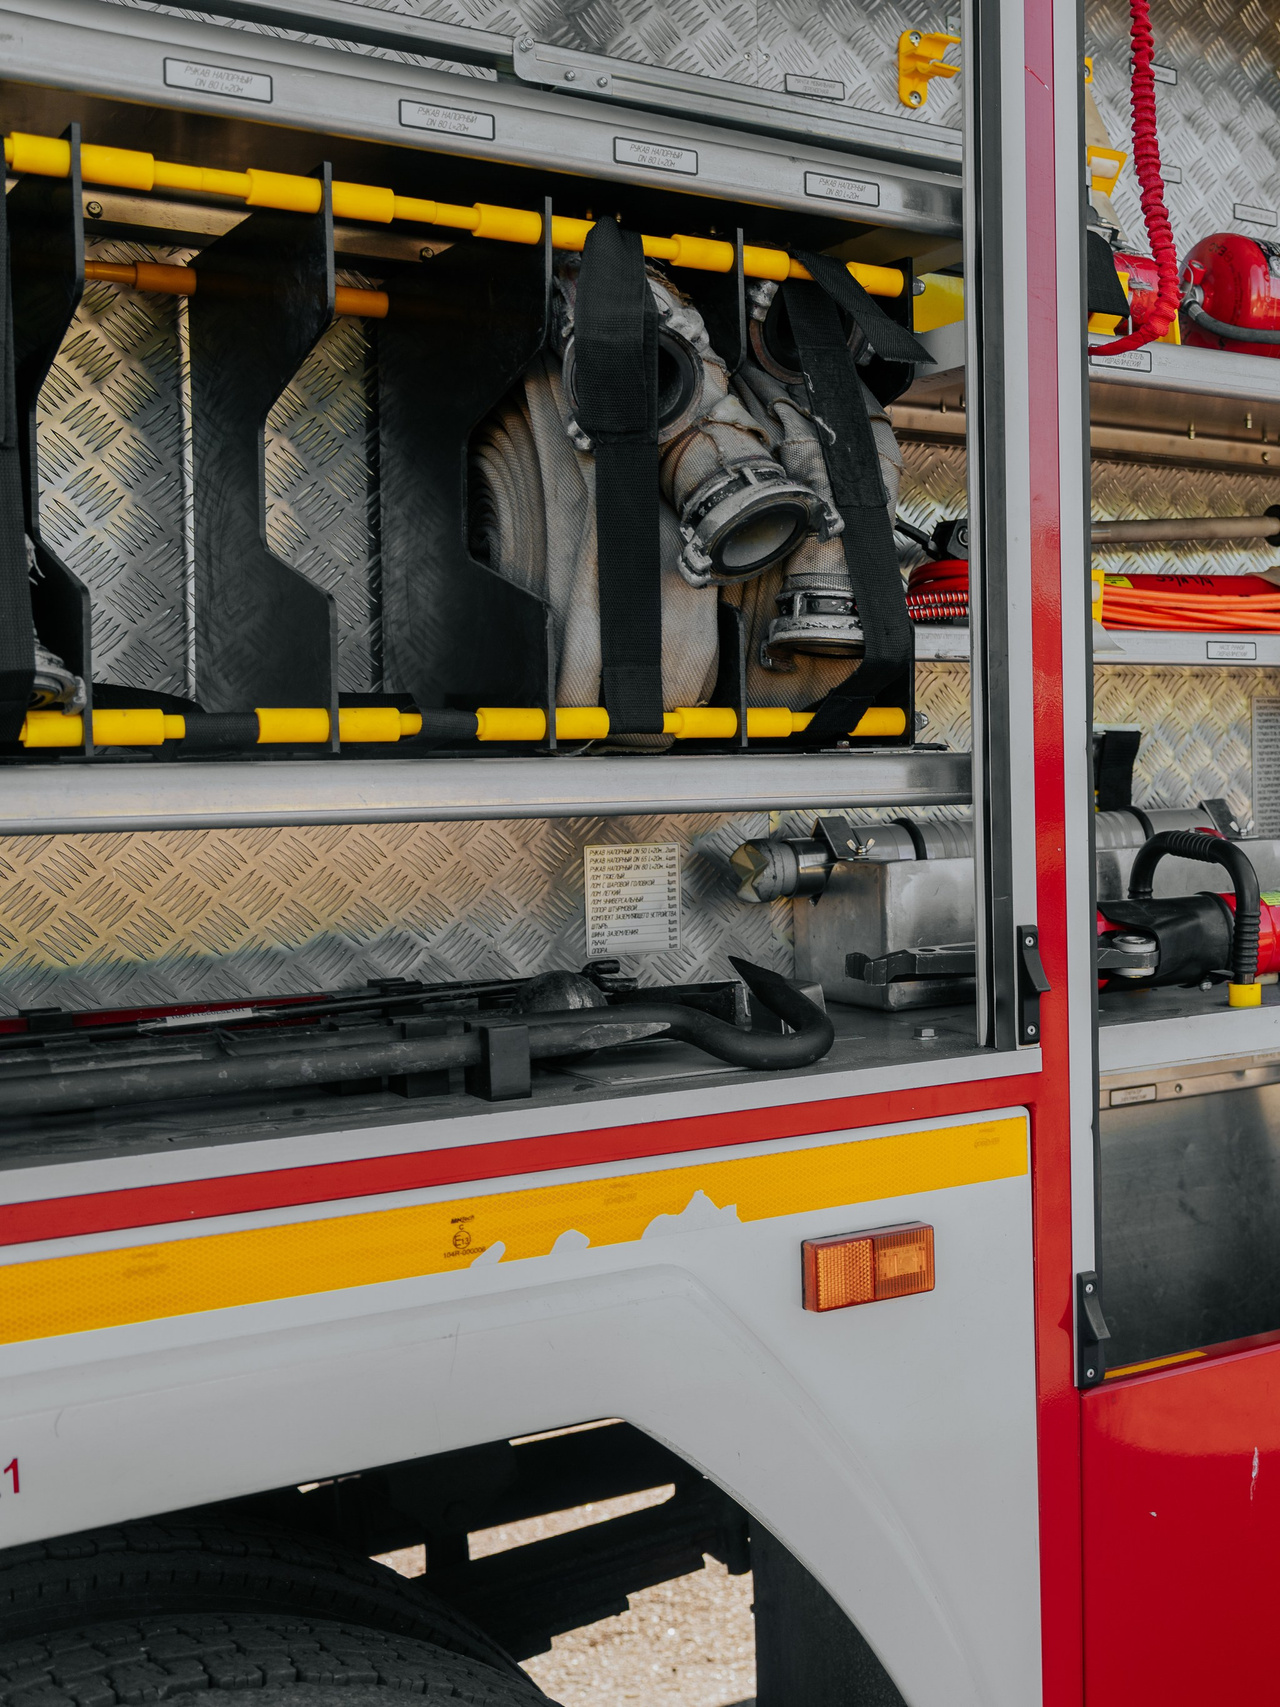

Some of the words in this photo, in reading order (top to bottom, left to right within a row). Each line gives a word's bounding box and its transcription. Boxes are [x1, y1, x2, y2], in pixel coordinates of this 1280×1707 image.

[184, 66, 210, 76] РУКАВ
[212, 69, 253, 84] НАПОРНЫЙ
[195, 78, 206, 87] DN
[209, 80, 219, 89] 80
[418, 107, 440, 117] РУКАВ
[442, 110, 477, 123] НАПОРНЫЙ
[427, 118, 436, 127] DN
[438, 120, 447, 128] 80
[630, 144, 649, 153] РУКАВ
[651, 147, 683, 159] НАПОРНЫЙ
[638, 155, 646, 163] DN
[649, 156, 656, 164] 80
[819, 178, 836, 187] РУКАВ
[838, 180, 866, 192] НАПОРНЫЙ
